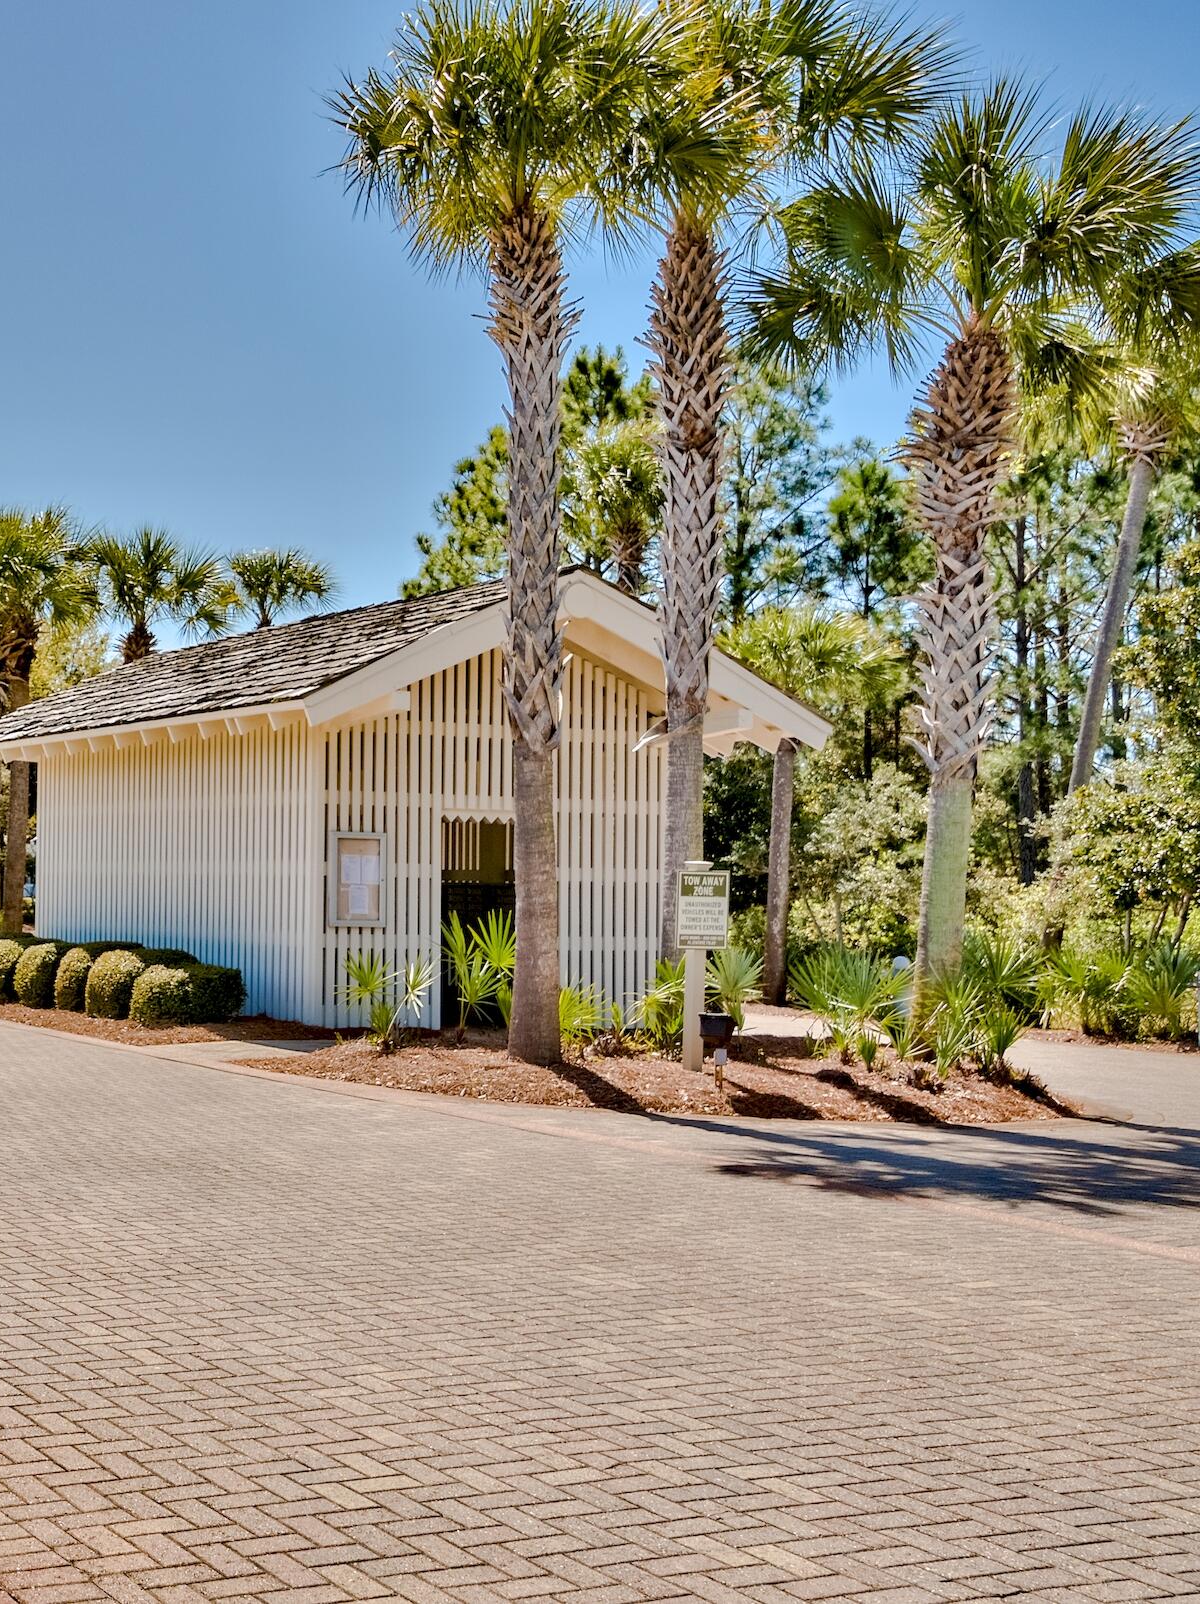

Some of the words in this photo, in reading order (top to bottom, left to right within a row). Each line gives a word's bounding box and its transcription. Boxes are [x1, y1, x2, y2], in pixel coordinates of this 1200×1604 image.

[683, 876, 700, 886] TOW
[701, 876, 725, 886] AWAY
[692, 886, 714, 896] ZONE
